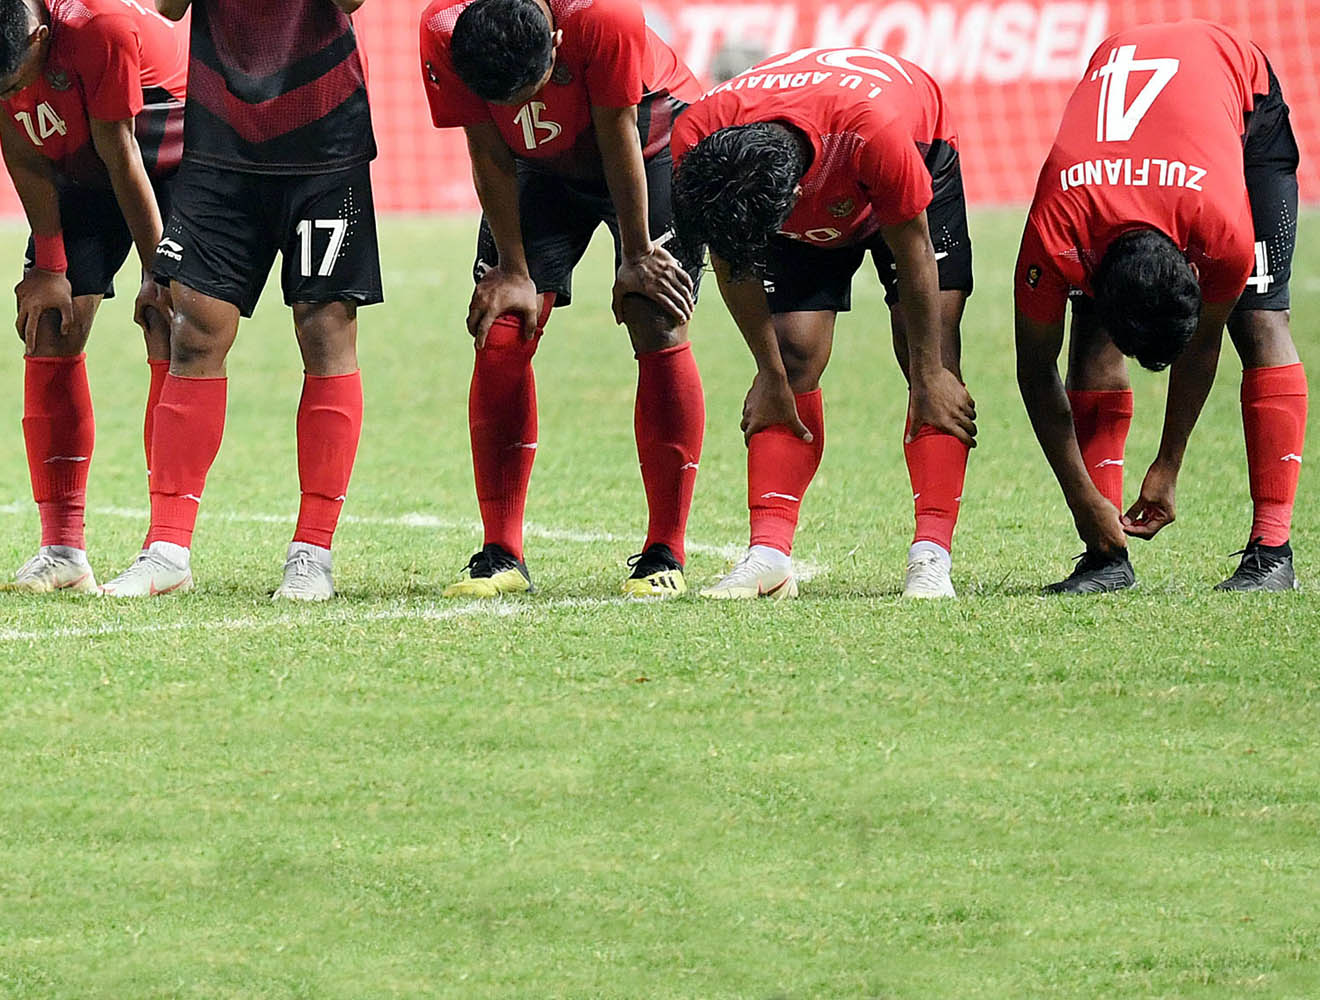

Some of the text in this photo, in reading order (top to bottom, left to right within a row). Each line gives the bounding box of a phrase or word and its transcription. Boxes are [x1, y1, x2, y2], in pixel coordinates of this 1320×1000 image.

[1090, 44, 1180, 142] 4
[14, 100, 68, 147] 14
[512, 101, 562, 150] 15
[1059, 158, 1208, 192] ZULFIANDI
[296, 218, 348, 277] 17
